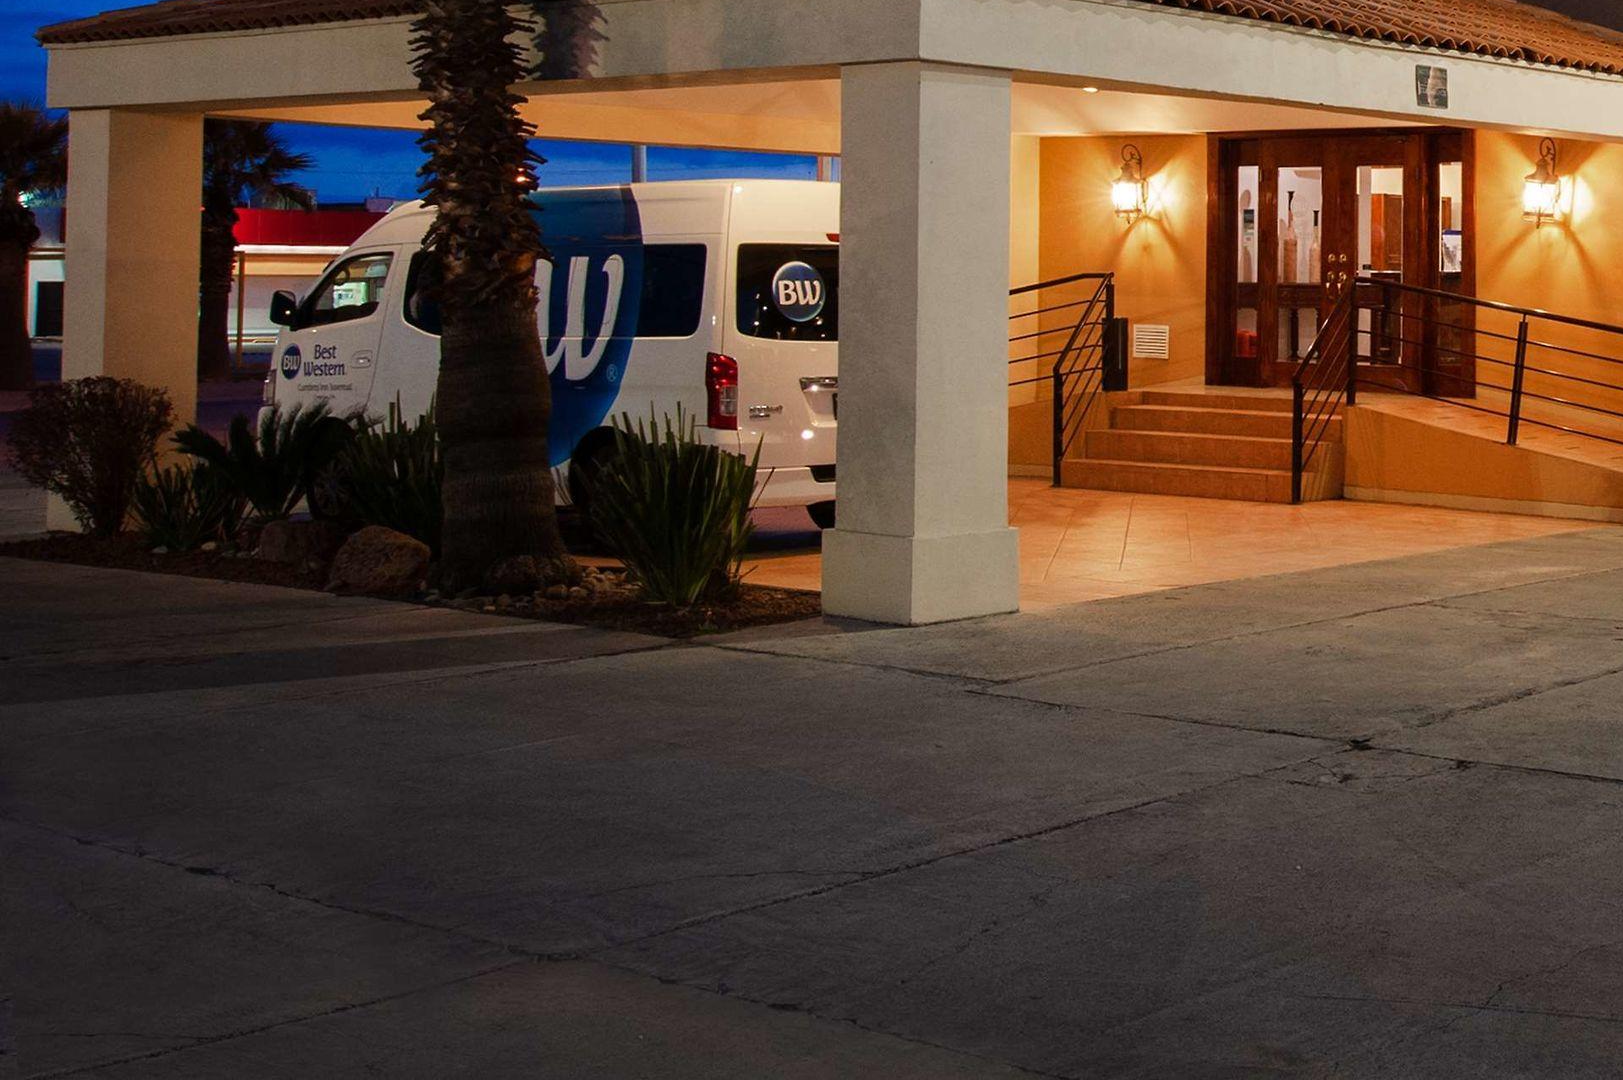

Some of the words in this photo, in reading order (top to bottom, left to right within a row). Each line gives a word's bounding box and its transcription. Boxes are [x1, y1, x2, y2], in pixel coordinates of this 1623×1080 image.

[778, 279, 821, 306] BW
[314, 344, 337, 360] Best
[283, 355, 300, 370] BW
[303, 361, 345, 377] Western
